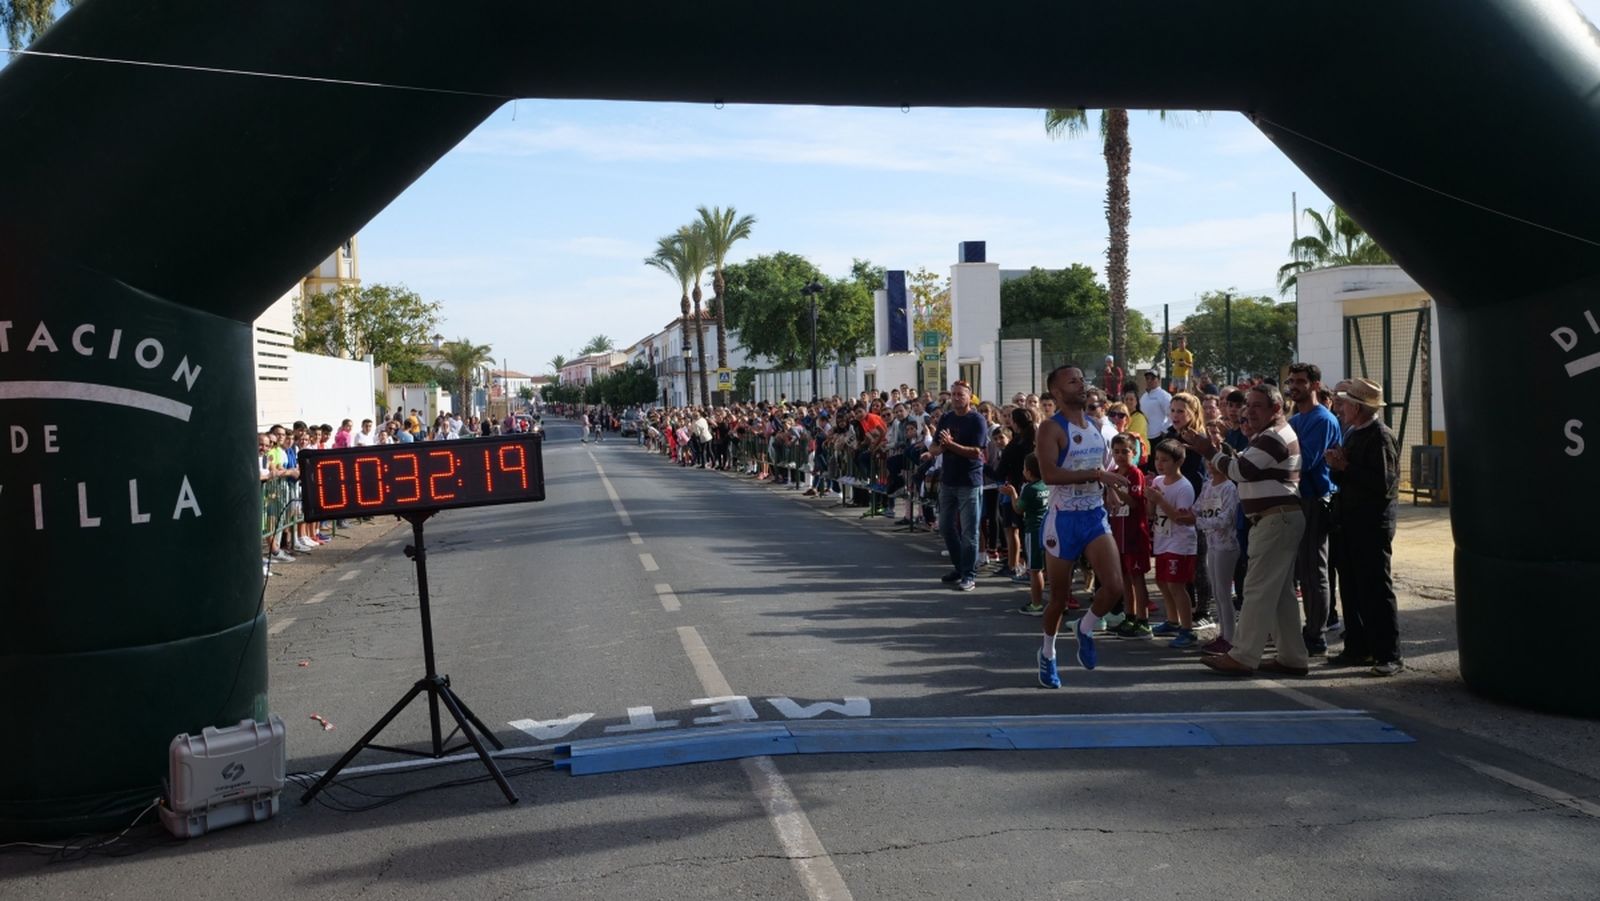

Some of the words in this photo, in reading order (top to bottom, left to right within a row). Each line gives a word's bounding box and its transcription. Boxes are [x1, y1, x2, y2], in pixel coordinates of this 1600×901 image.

[10, 424, 60, 454] DE
[0, 474, 202, 531] ILLA
[316, 444, 529, 510] 00:32:19
[506, 694, 872, 741] META
